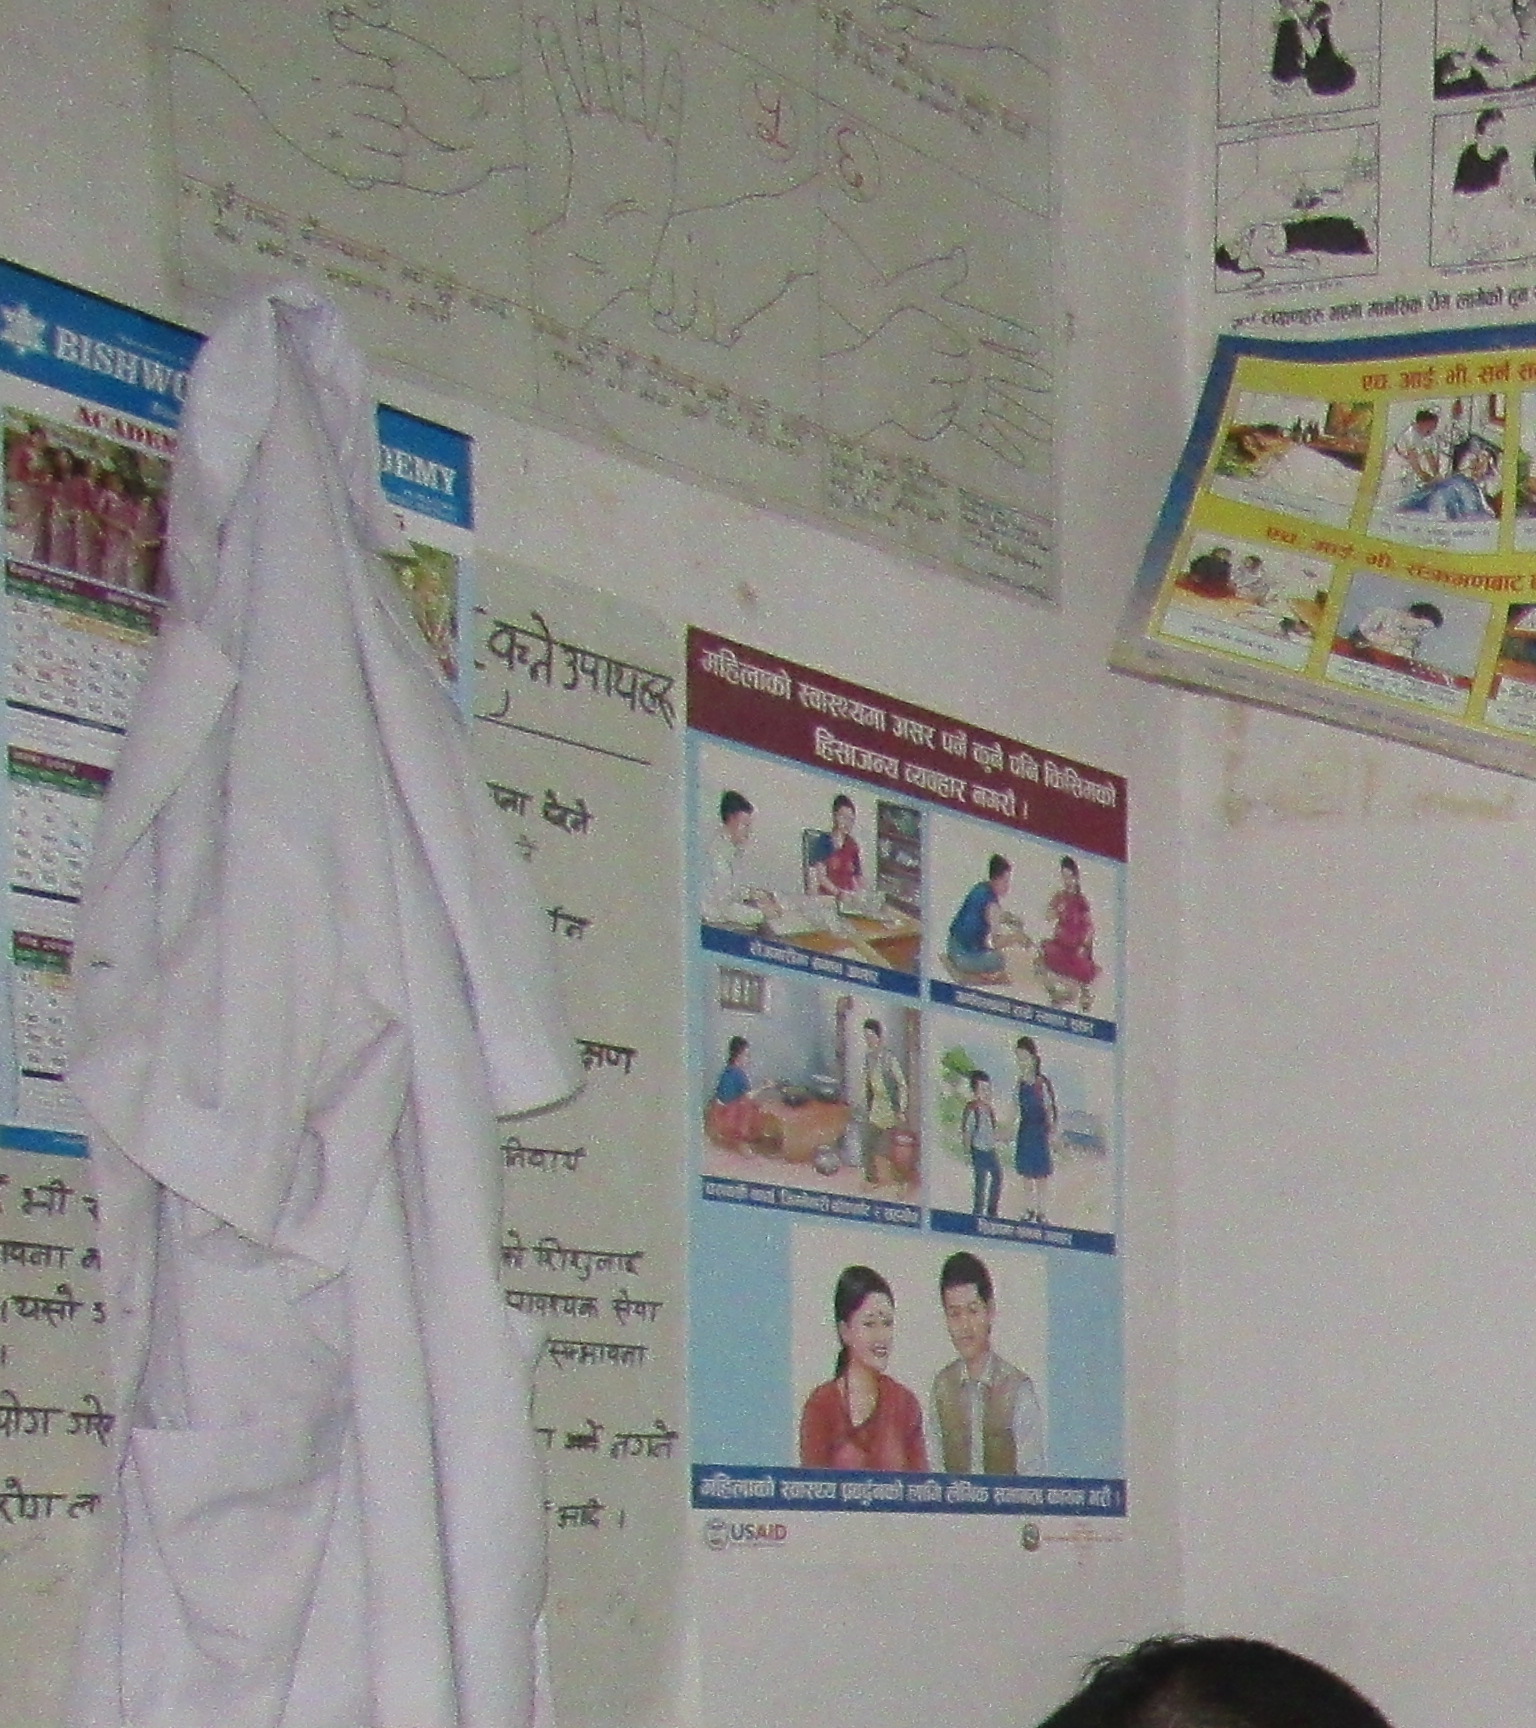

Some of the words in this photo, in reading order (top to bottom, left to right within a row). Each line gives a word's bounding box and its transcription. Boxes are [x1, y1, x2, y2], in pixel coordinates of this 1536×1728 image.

[702, 649, 790, 700] महिलाको
[893, 713, 935, 751] असर
[731, 1523, 788, 1541] USAID
